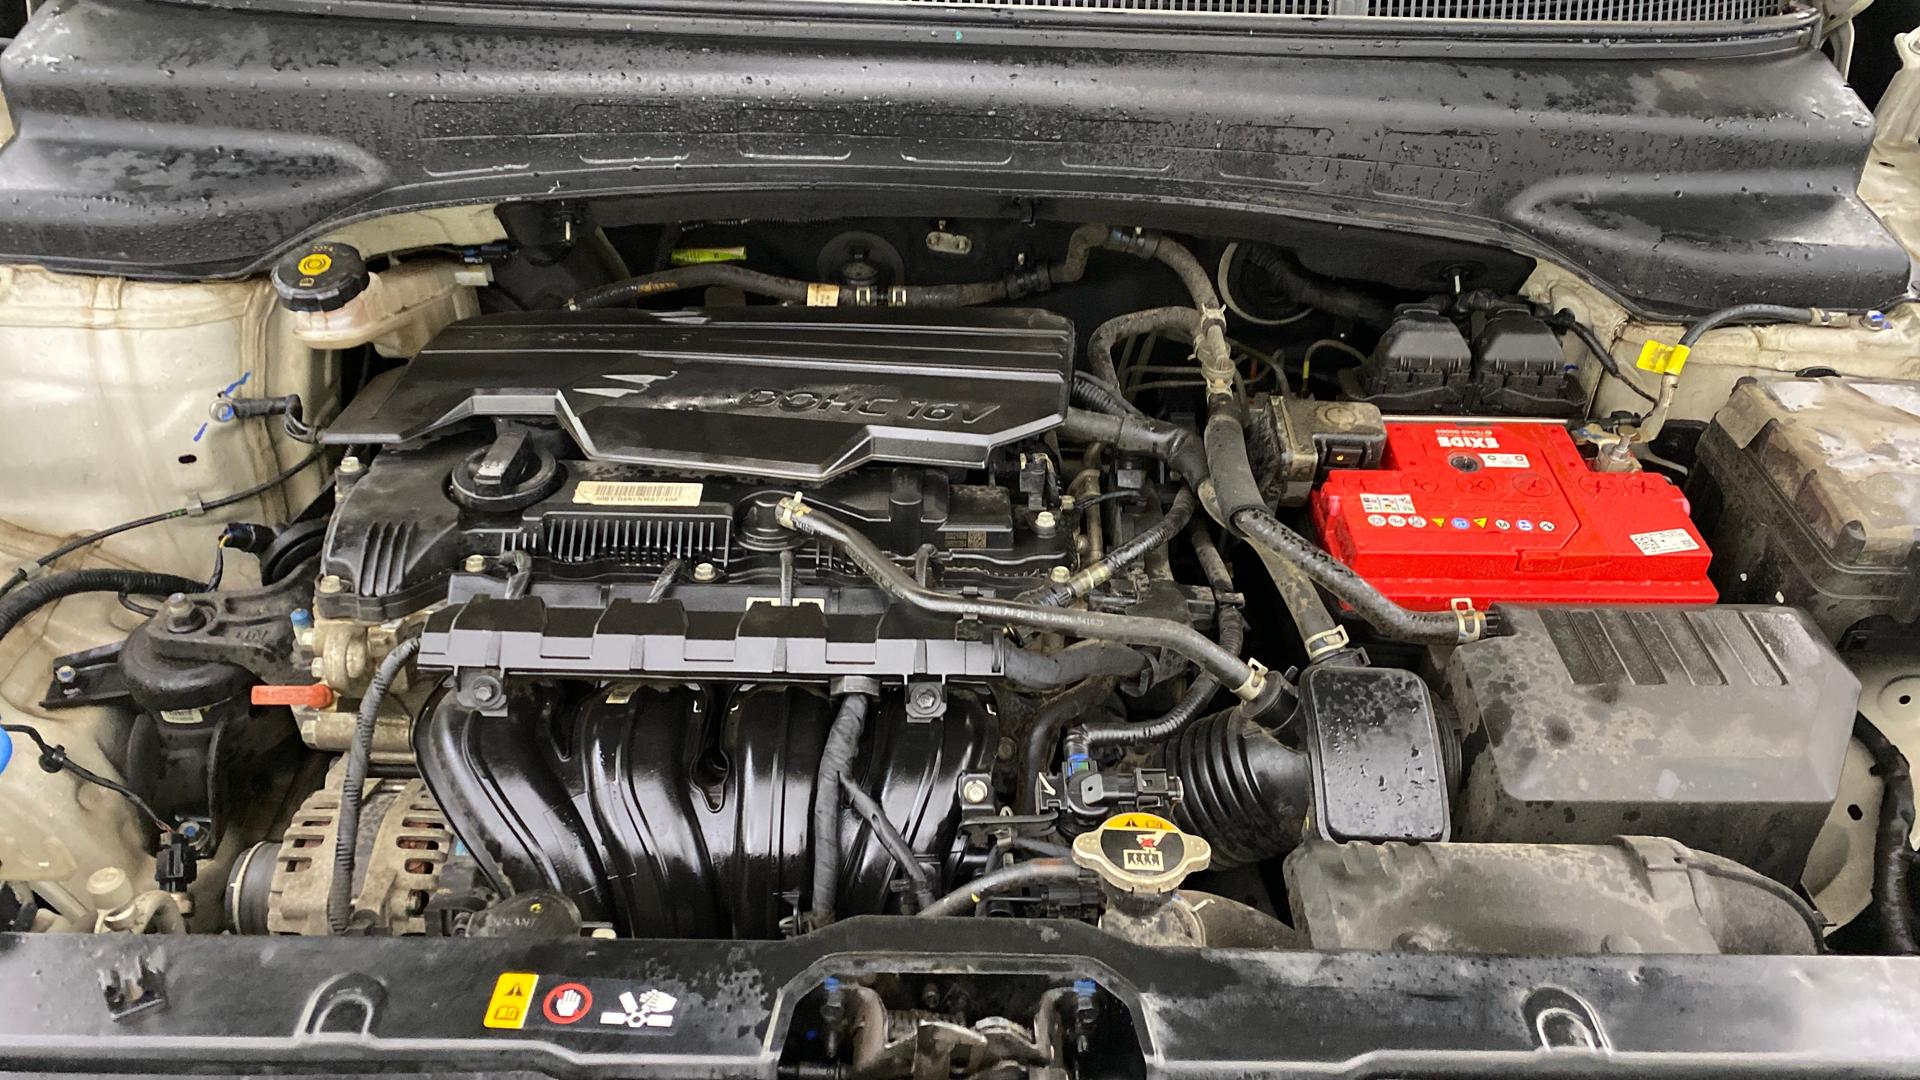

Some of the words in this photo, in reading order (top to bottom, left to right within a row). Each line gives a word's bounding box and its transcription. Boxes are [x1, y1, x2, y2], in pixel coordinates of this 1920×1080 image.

[744, 387, 899, 417] DOHC
[905, 399, 1001, 424] 16V
[1436, 436, 1500, 449] EXIDE
